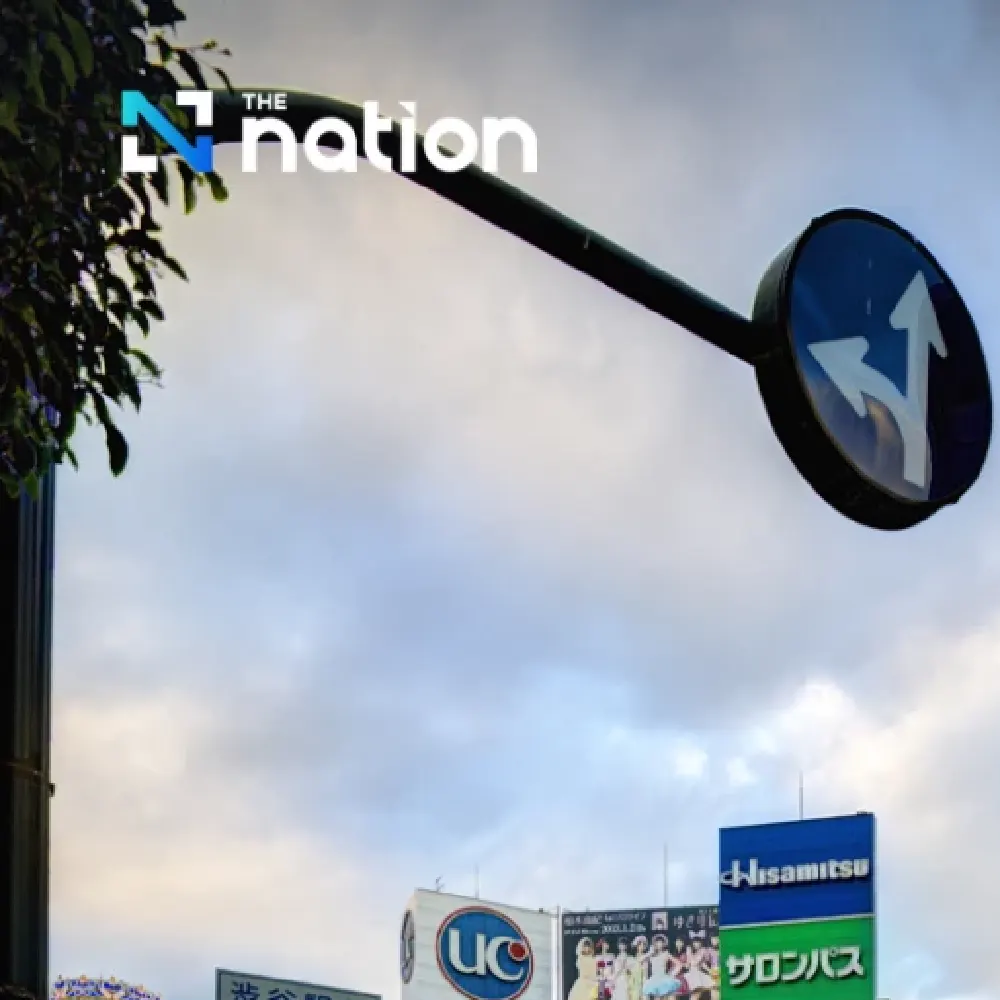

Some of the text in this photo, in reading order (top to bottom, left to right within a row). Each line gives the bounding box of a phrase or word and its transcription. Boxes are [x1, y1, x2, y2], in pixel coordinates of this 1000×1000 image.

[719, 857, 870, 888] Hisamitsu
[726, 945, 864, 985] サロンパス
